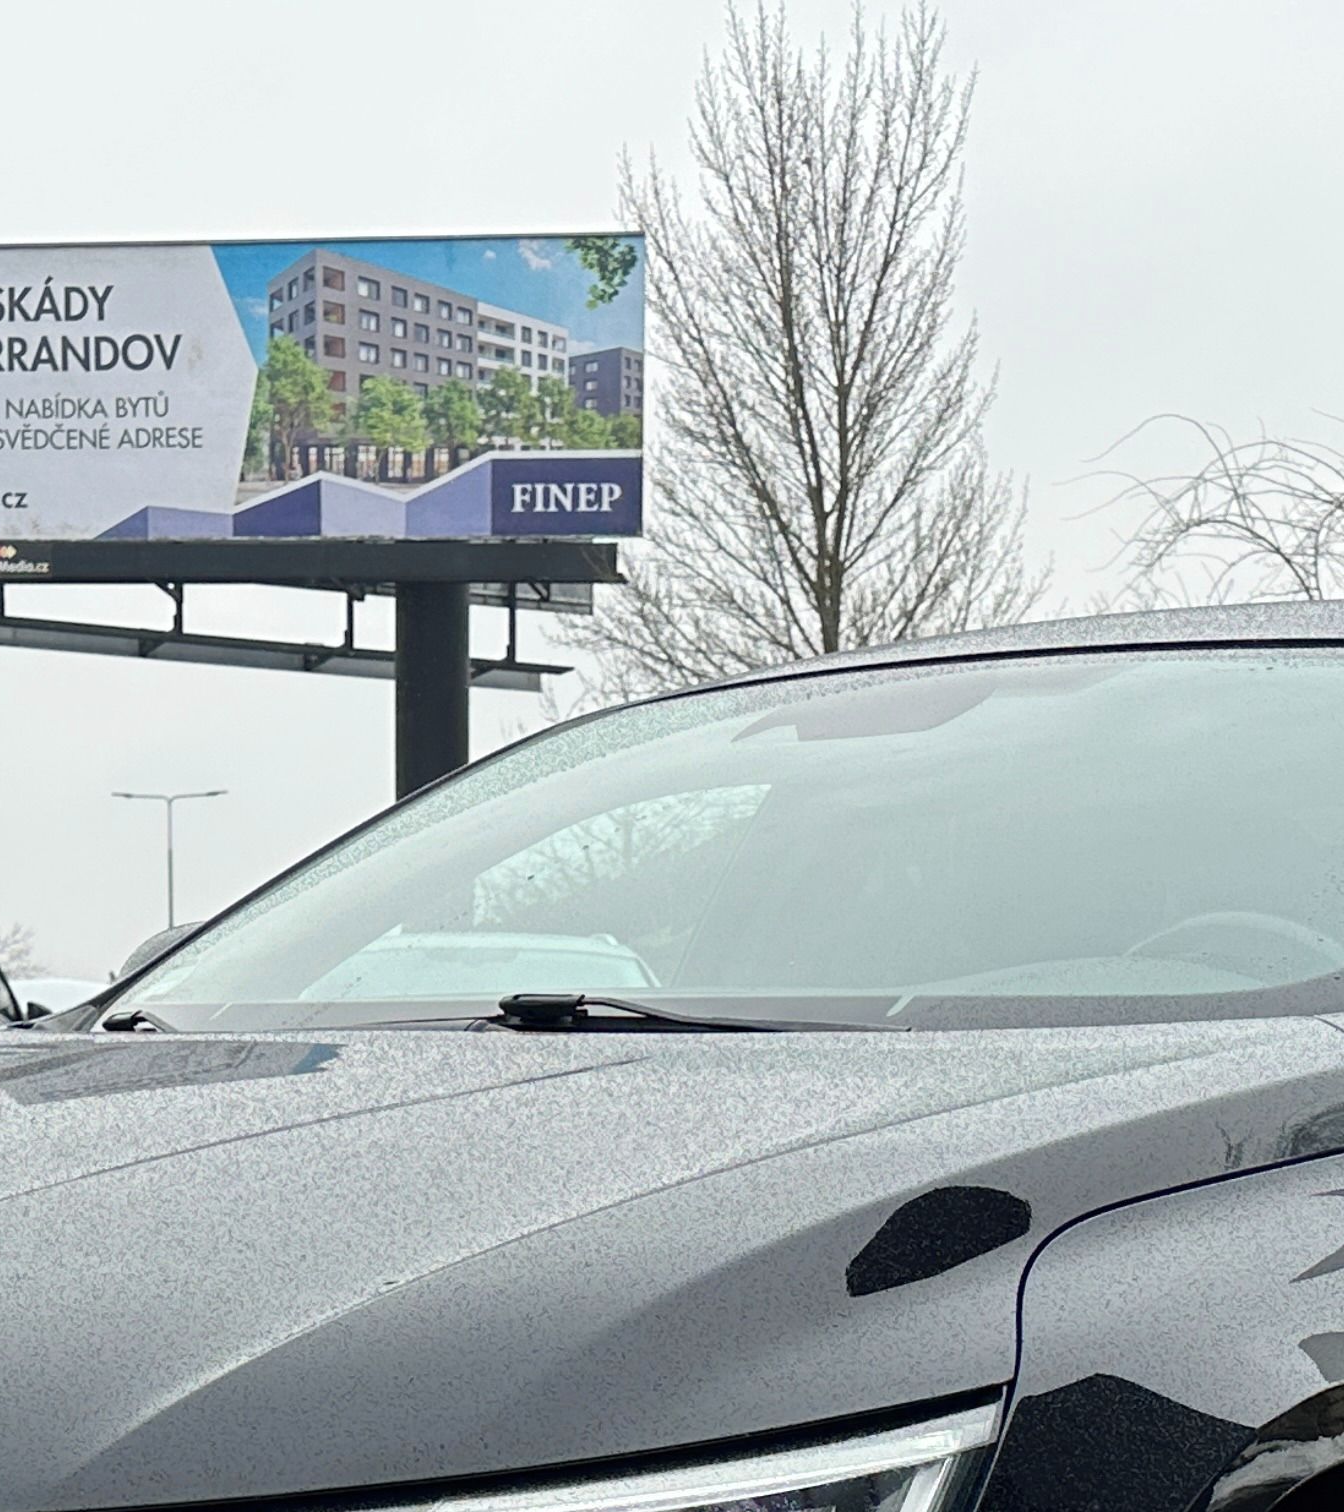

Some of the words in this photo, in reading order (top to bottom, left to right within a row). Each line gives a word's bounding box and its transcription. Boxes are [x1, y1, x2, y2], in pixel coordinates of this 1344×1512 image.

[6, 392, 108, 419] NABÍDKA
[115, 390, 169, 418] BYTŮ
[117, 427, 203, 449] ADRESE
[511, 482, 623, 513] FINEP
